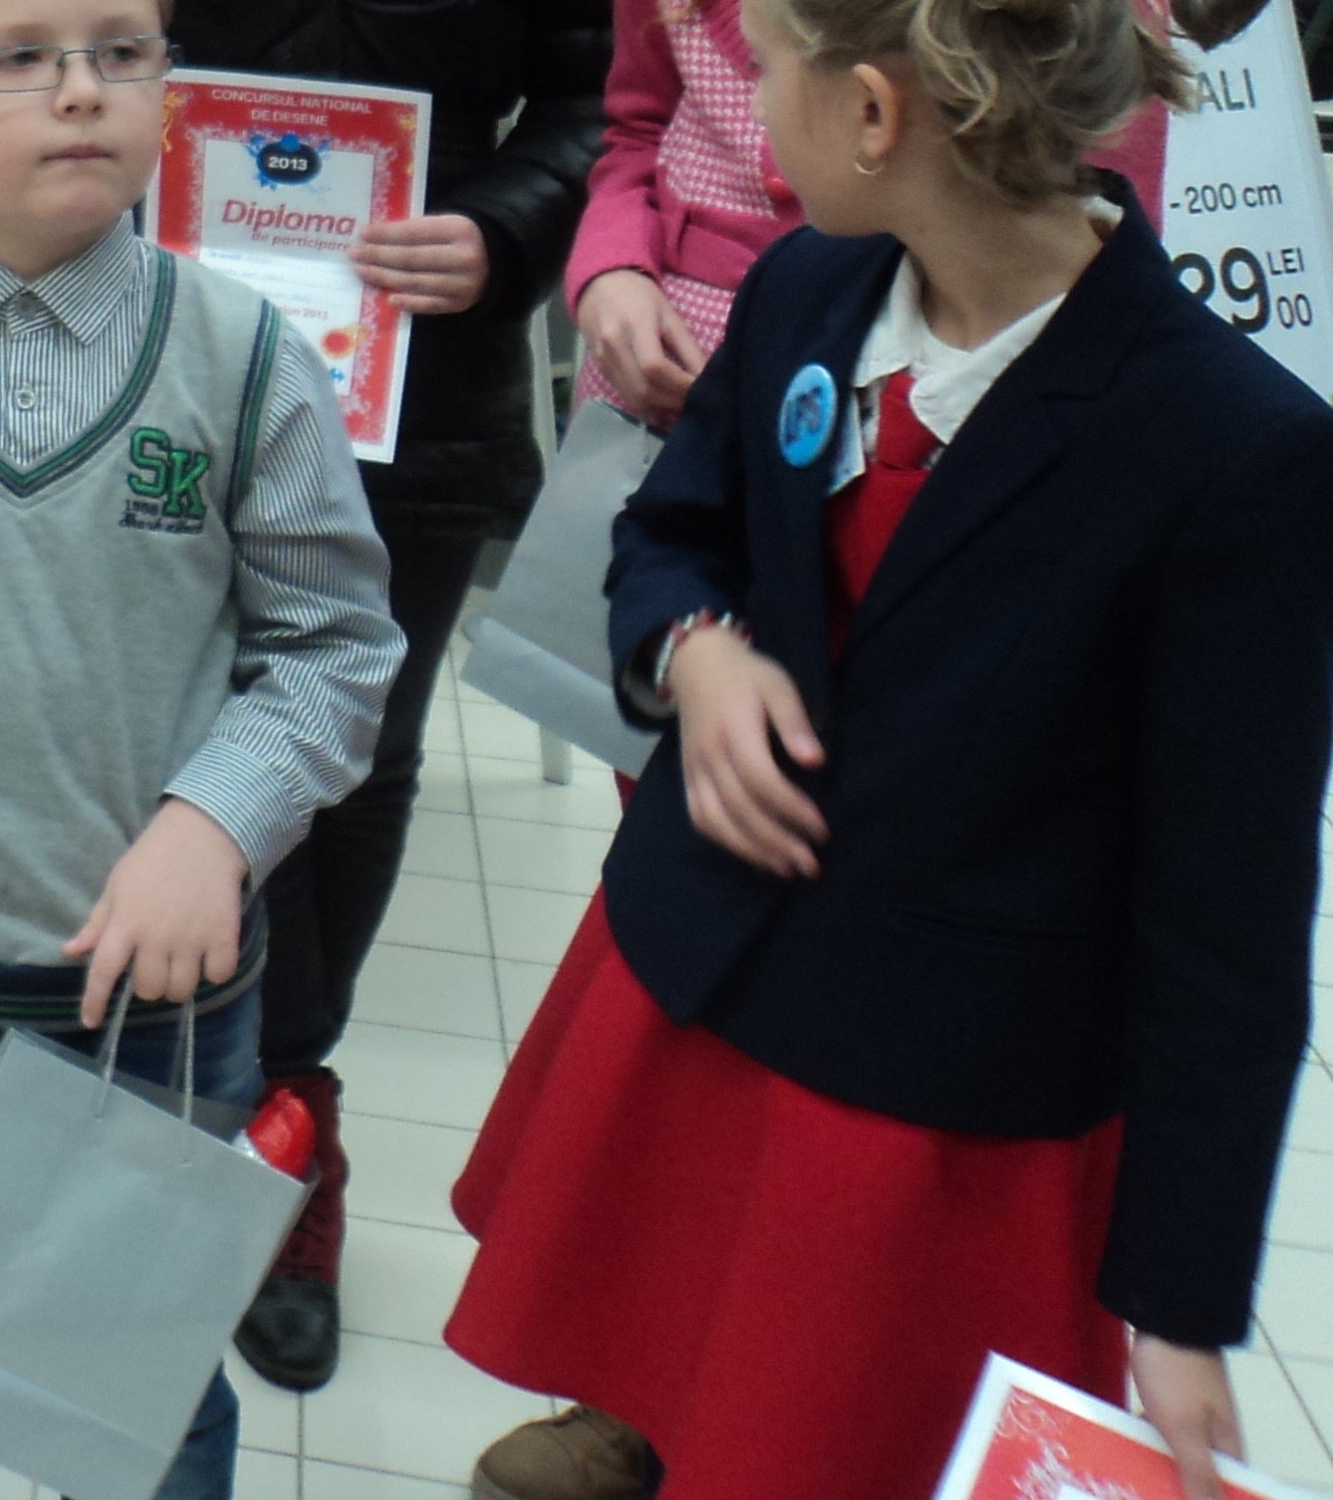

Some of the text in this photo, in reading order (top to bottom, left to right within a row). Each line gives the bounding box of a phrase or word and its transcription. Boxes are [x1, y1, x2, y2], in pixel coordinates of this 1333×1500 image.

[211, 88, 298, 107] CONCURSUL
[251, 109, 329, 126] DE DESENE
[268, 157, 308, 171] 2013
[1185, 183, 1237, 214] 200
[1243, 184, 1283, 209] cm
[222, 199, 356, 236] Diploma
[271, 234, 352, 251] participare
[1267, 247, 1313, 329] LEI 00
[127, 426, 211, 520] SK
